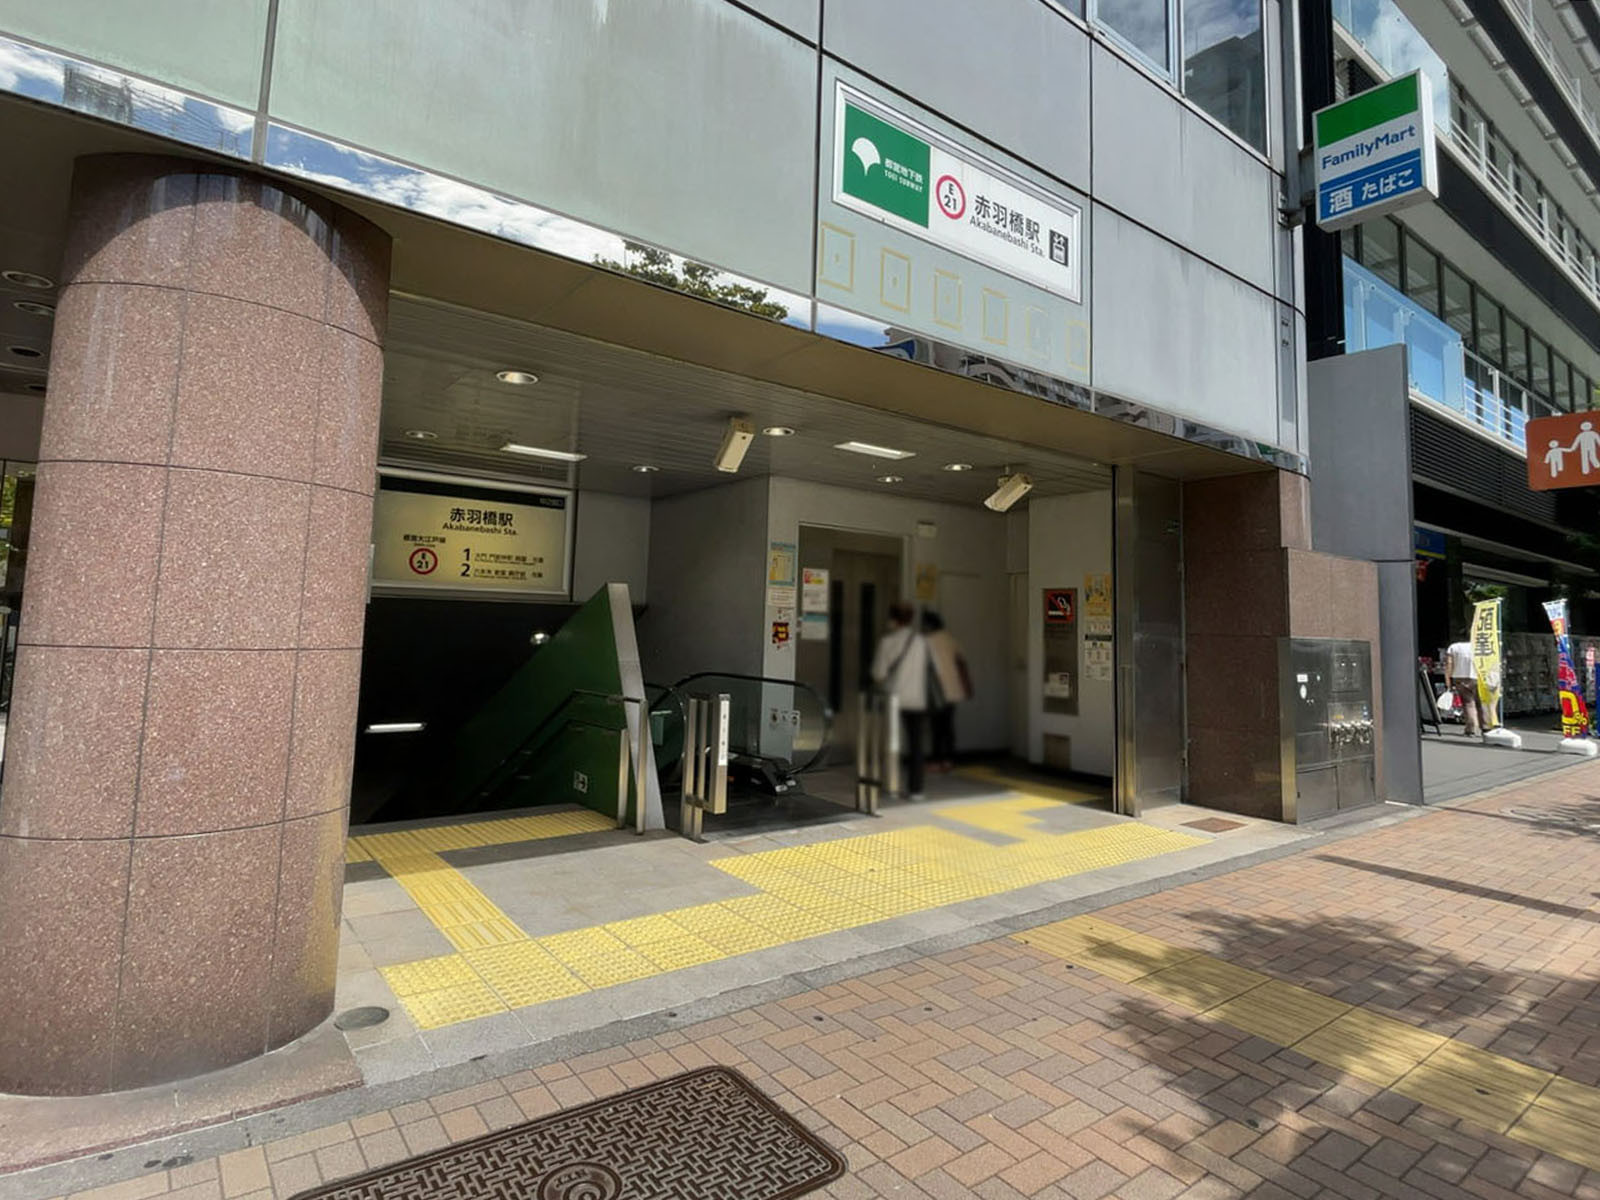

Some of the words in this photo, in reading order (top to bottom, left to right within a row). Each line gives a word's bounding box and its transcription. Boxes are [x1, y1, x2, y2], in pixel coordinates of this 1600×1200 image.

[1321, 124, 1416, 170] FamilyMart
[948, 183, 955, 195] E
[1329, 185, 1353, 214] 酒
[1361, 168, 1414, 201] たばこ
[944, 197, 957, 211] 21
[974, 194, 1041, 243] 赤羽橋駅
[970, 216, 1029, 251] Akabanebashi
[1030, 242, 1046, 258] Sta.
[449, 507, 514, 527] 赤羽橋駅
[442, 522, 502, 534] Akabanebashi
[463, 547, 471, 561] 1
[416, 560, 429, 569] 21
[460, 563, 471, 577] 2
